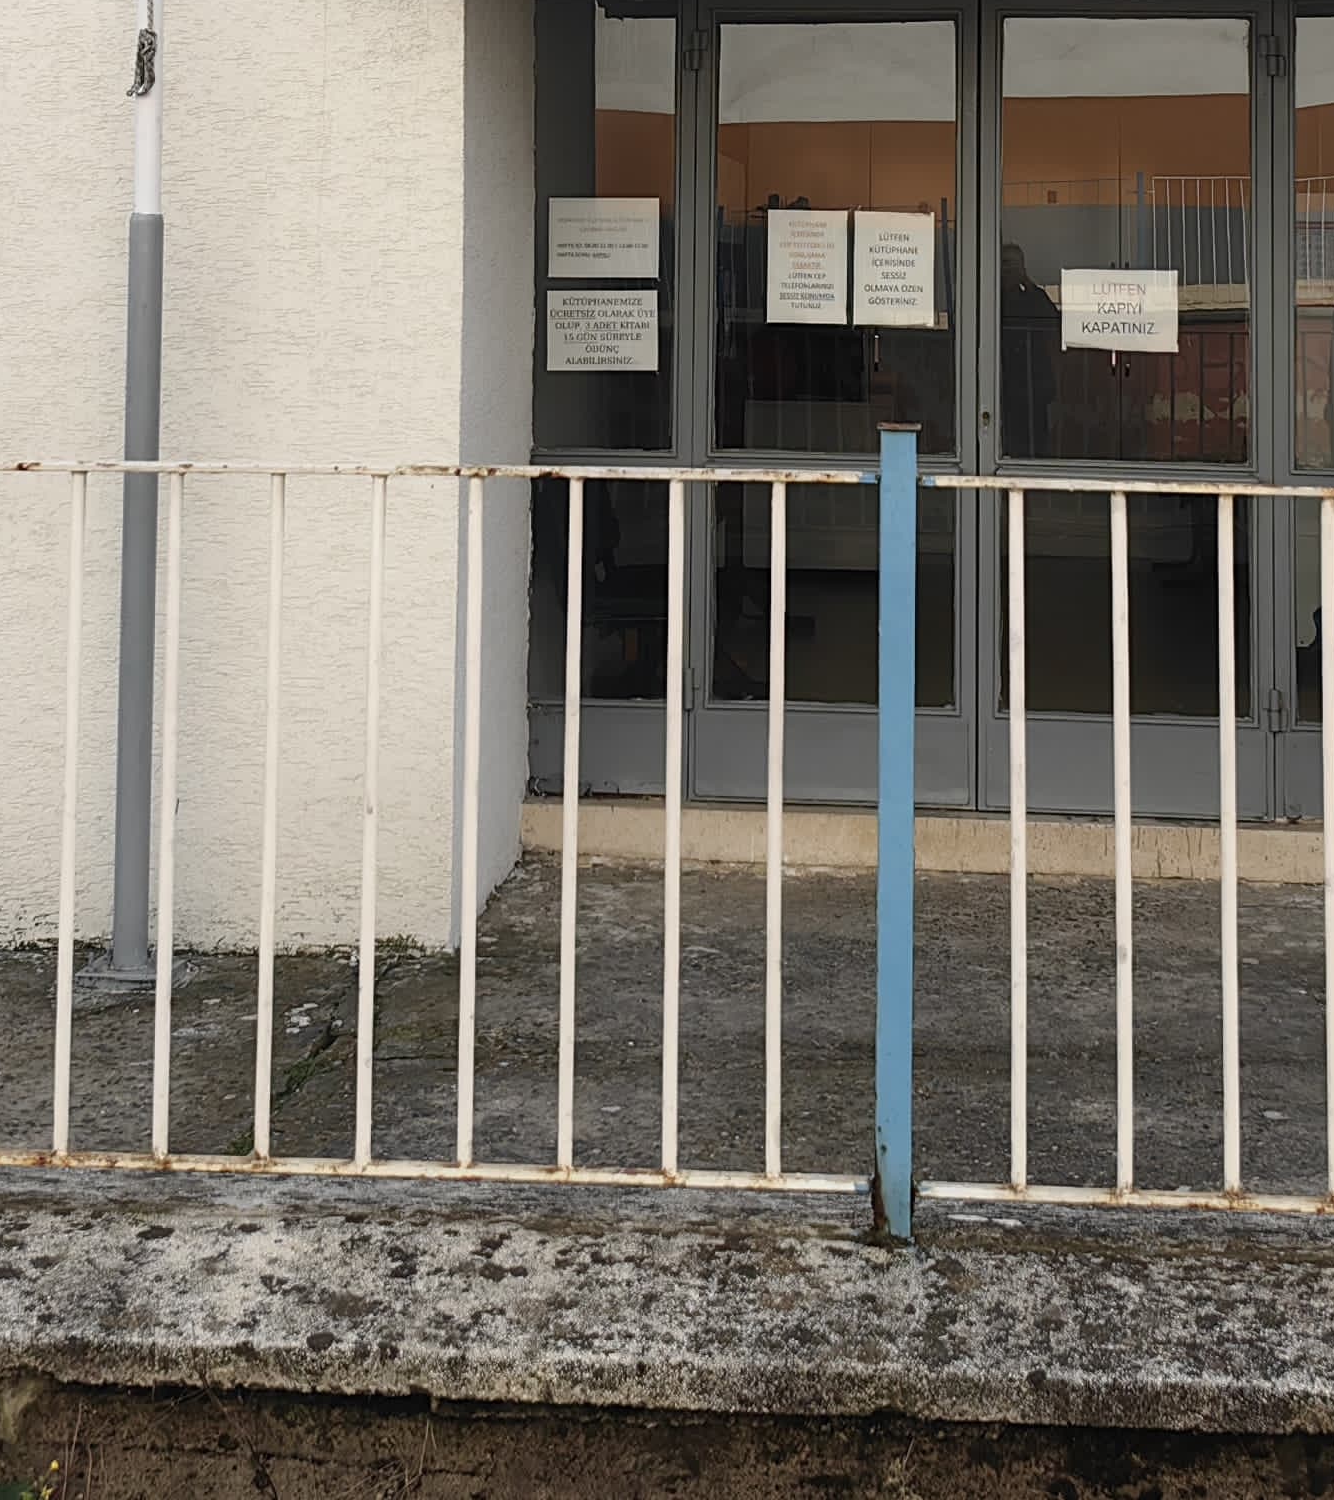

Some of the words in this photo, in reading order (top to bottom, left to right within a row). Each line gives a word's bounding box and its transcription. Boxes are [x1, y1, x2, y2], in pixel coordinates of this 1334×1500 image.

[863, 283, 899, 293] OLMAYA
[597, 309, 635, 317] OLARAK
[1097, 302, 1142, 315] KAPIYI
[593, 321, 618, 330] ADET
[564, 332, 574, 341] 15
[576, 331, 597, 341] GÜN
